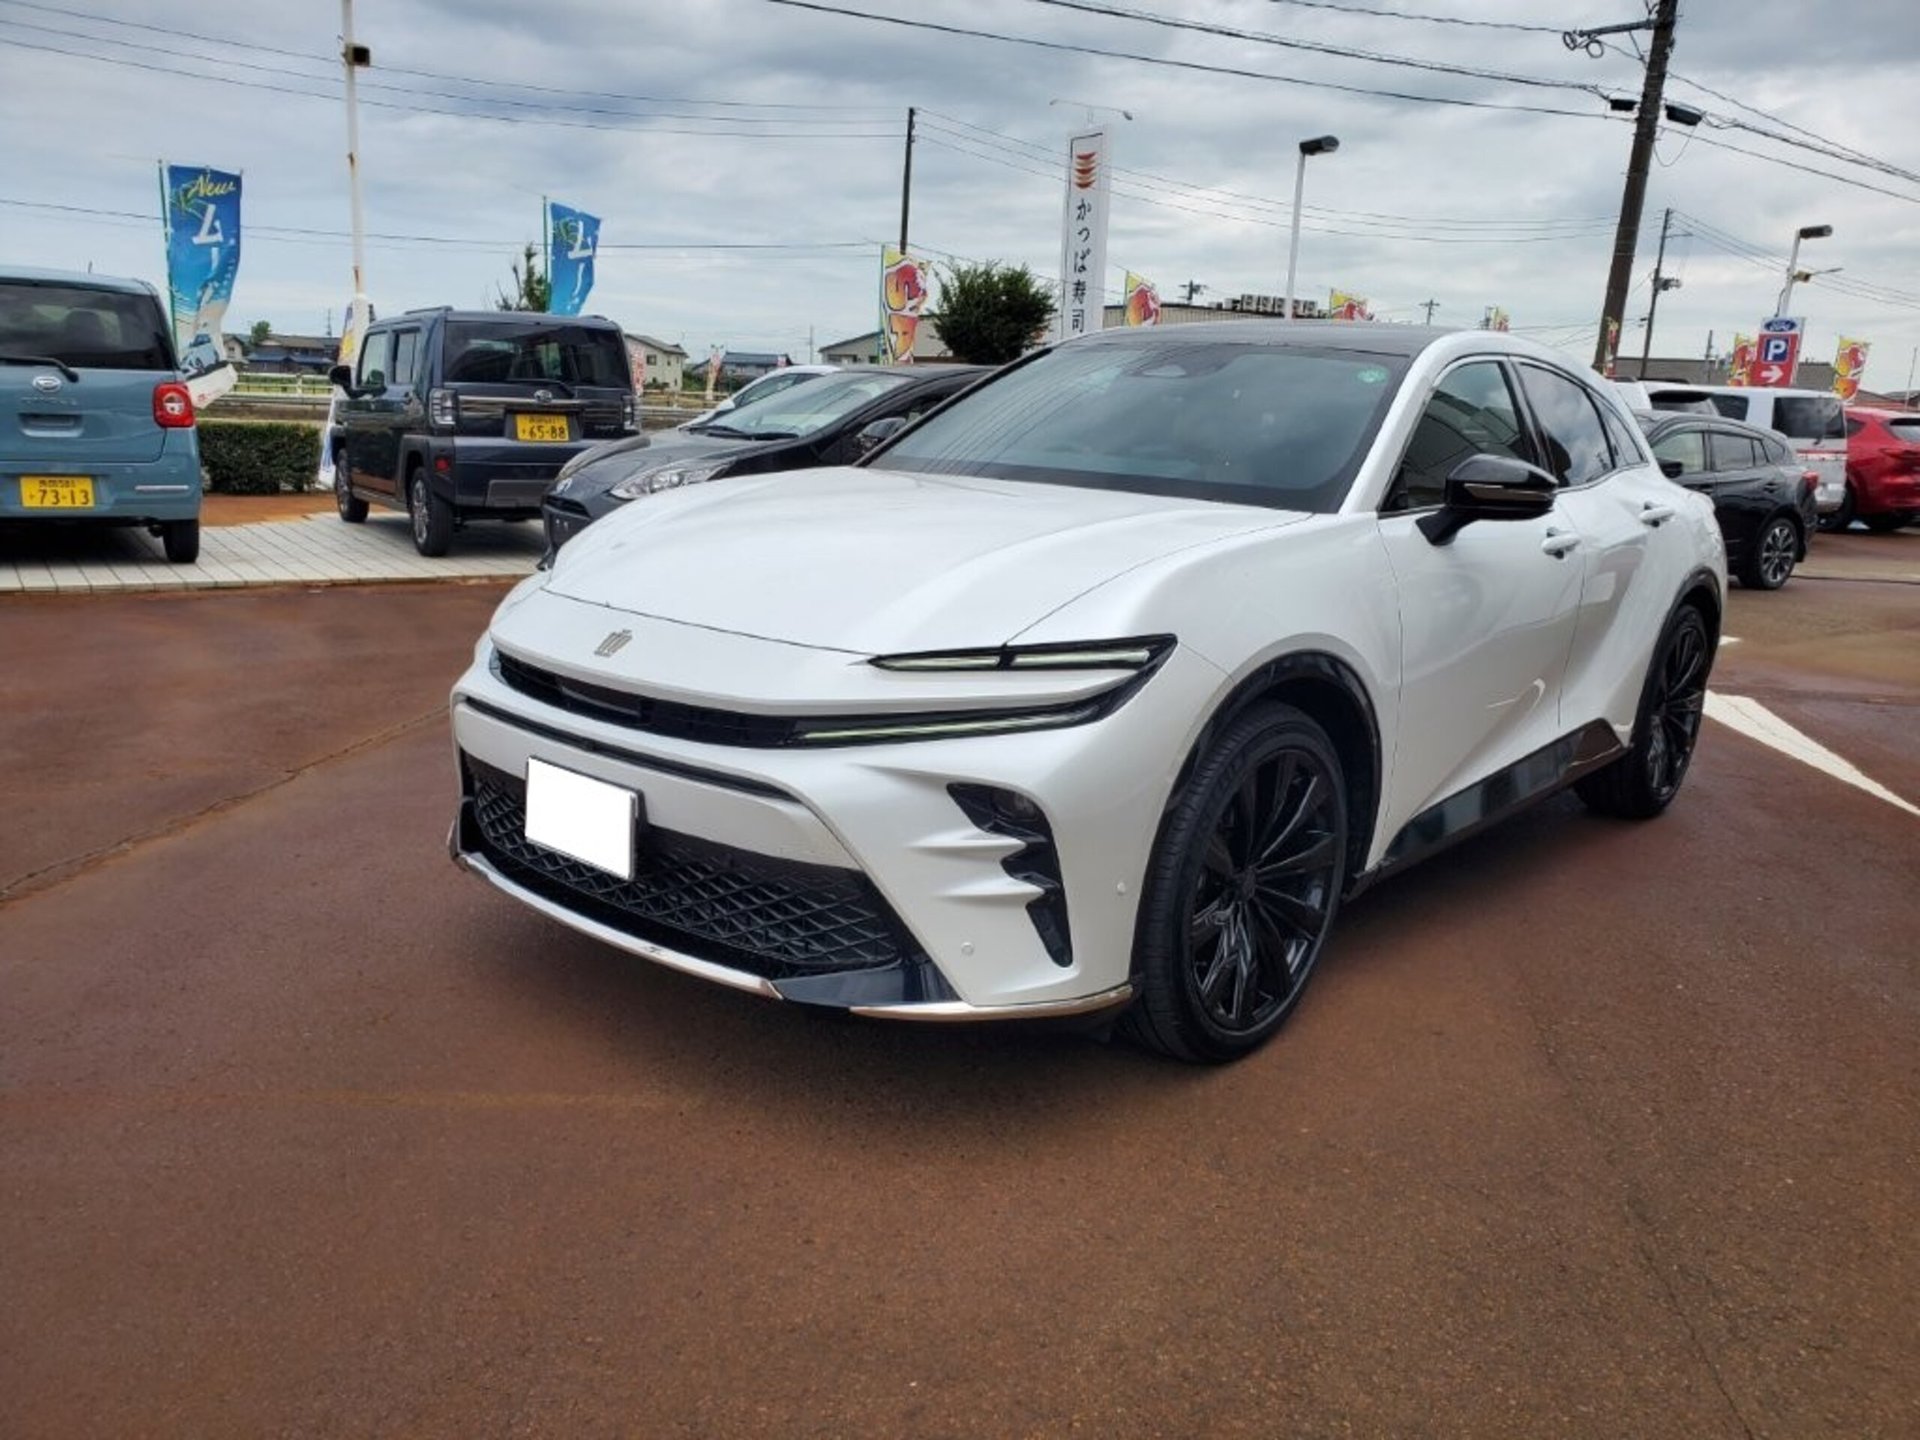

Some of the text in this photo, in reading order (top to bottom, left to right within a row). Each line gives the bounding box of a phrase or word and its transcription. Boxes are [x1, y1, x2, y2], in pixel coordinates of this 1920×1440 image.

[187, 174, 236, 198] New
[1767, 340, 1787, 361] P
[38, 489, 90, 505] 73-13
